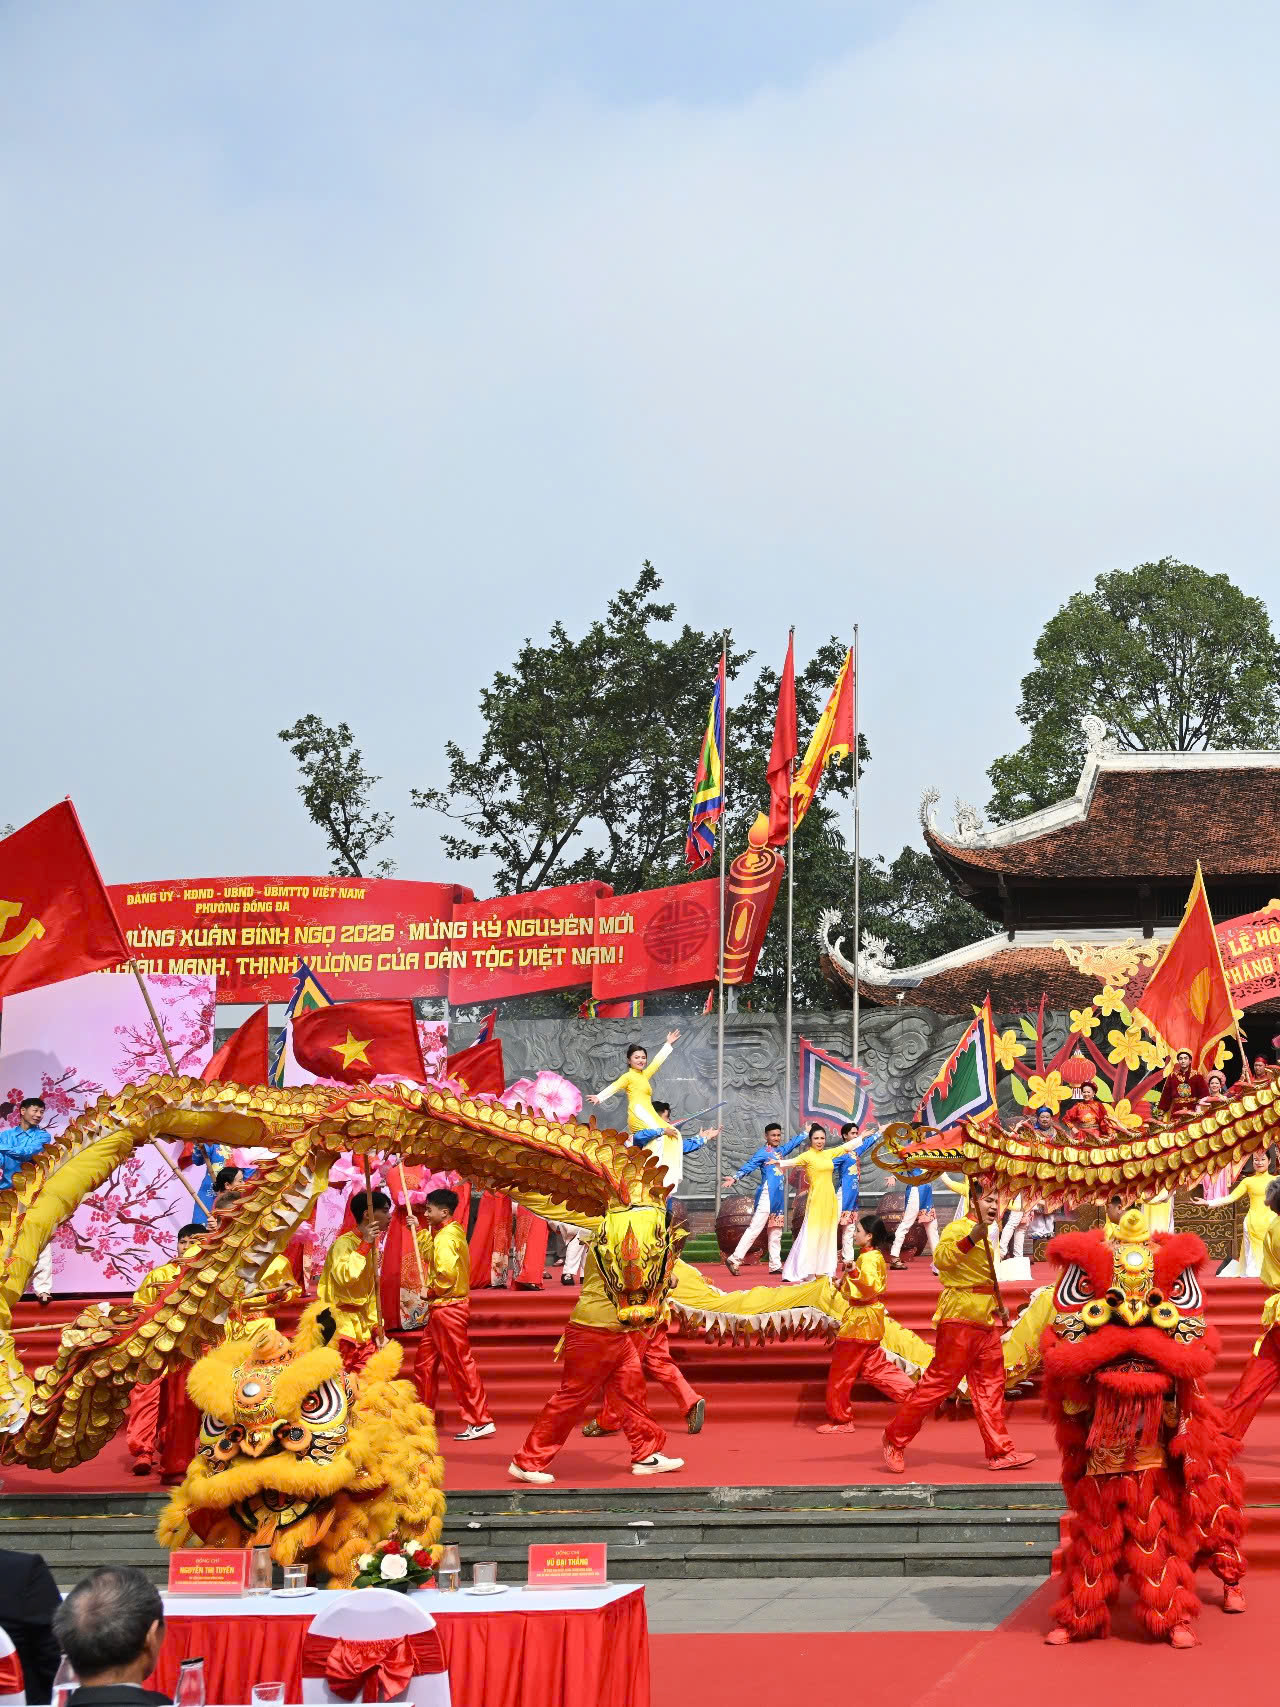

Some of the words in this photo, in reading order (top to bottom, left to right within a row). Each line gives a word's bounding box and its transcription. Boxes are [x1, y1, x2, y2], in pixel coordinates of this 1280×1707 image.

[127, 892, 157, 905] ĐẢNG
[160, 889, 173, 902] ỦY
[184, 889, 214, 901] HĐND
[224, 887, 254, 898] UBND
[264, 886, 309, 900] UBMTTQ
[312, 886, 337, 900] VIỆT
[340, 888, 366, 900] NAM
[195, 901, 241, 914] PHƯỜNG
[243, 899, 273, 913] ĐỐNG
[276, 902, 290, 913] ĐA
[180, 924, 236, 947] XUÂN
[242, 922, 290, 946] BÍNH
[295, 927, 336, 949] NGỌ
[341, 924, 395, 943] 2026
[409, 917, 467, 941] MỪNG
[472, 915, 502, 939] KỶ
[507, 914, 594, 938] NGUYÊN
[599, 912, 635, 935] MỚI
[1228, 930, 1254, 957] LỄ
[236, 957, 298, 979] THỊNH
[304, 952, 373, 978] VƯỢNG
[377, 947, 419, 972] CỦA
[424, 947, 467, 970] DÂN
[472, 945, 514, 972] TỘC
[519, 944, 567, 970] VIỆT
